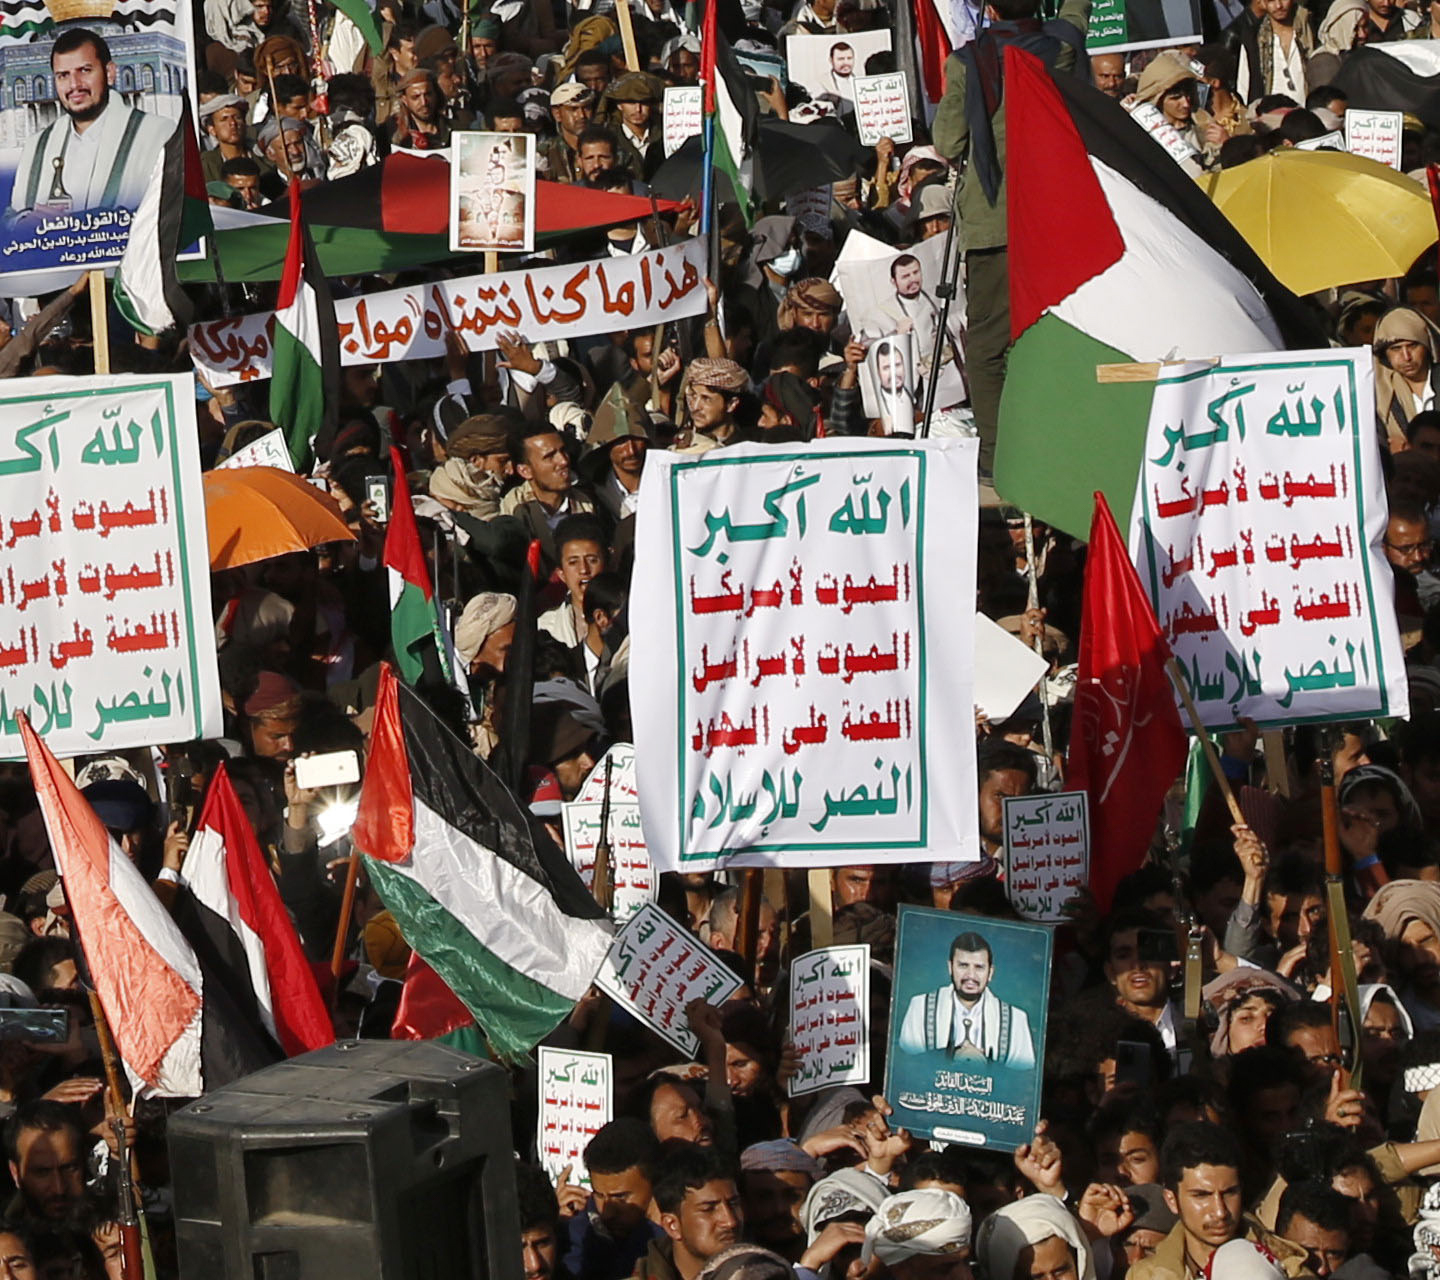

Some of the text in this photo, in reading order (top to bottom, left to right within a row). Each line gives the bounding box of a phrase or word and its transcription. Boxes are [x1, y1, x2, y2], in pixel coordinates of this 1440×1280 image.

[2, 239, 42, 256] الحوثي
[35, 215, 80, 236] والفعل
[81, 211, 118, 231] القول
[524, 263, 591, 325] كنا
[595, 262, 636, 316] ما
[642, 252, 699, 310] هذا
[79, 409, 166, 468] الله
[69, 485, 171, 541] الموت
[688, 469, 913, 567] الله أكبر
[75, 549, 176, 603] الموت
[689, 562, 913, 620] الموت لأمريكا
[47, 619, 96, 672] على
[104, 608, 182, 656] اللعنة
[815, 630, 913, 687] الموت
[85, 665, 187, 742] النصر
[690, 698, 914, 760] اللعنة على اليهود
[809, 757, 915, 835] النصر
